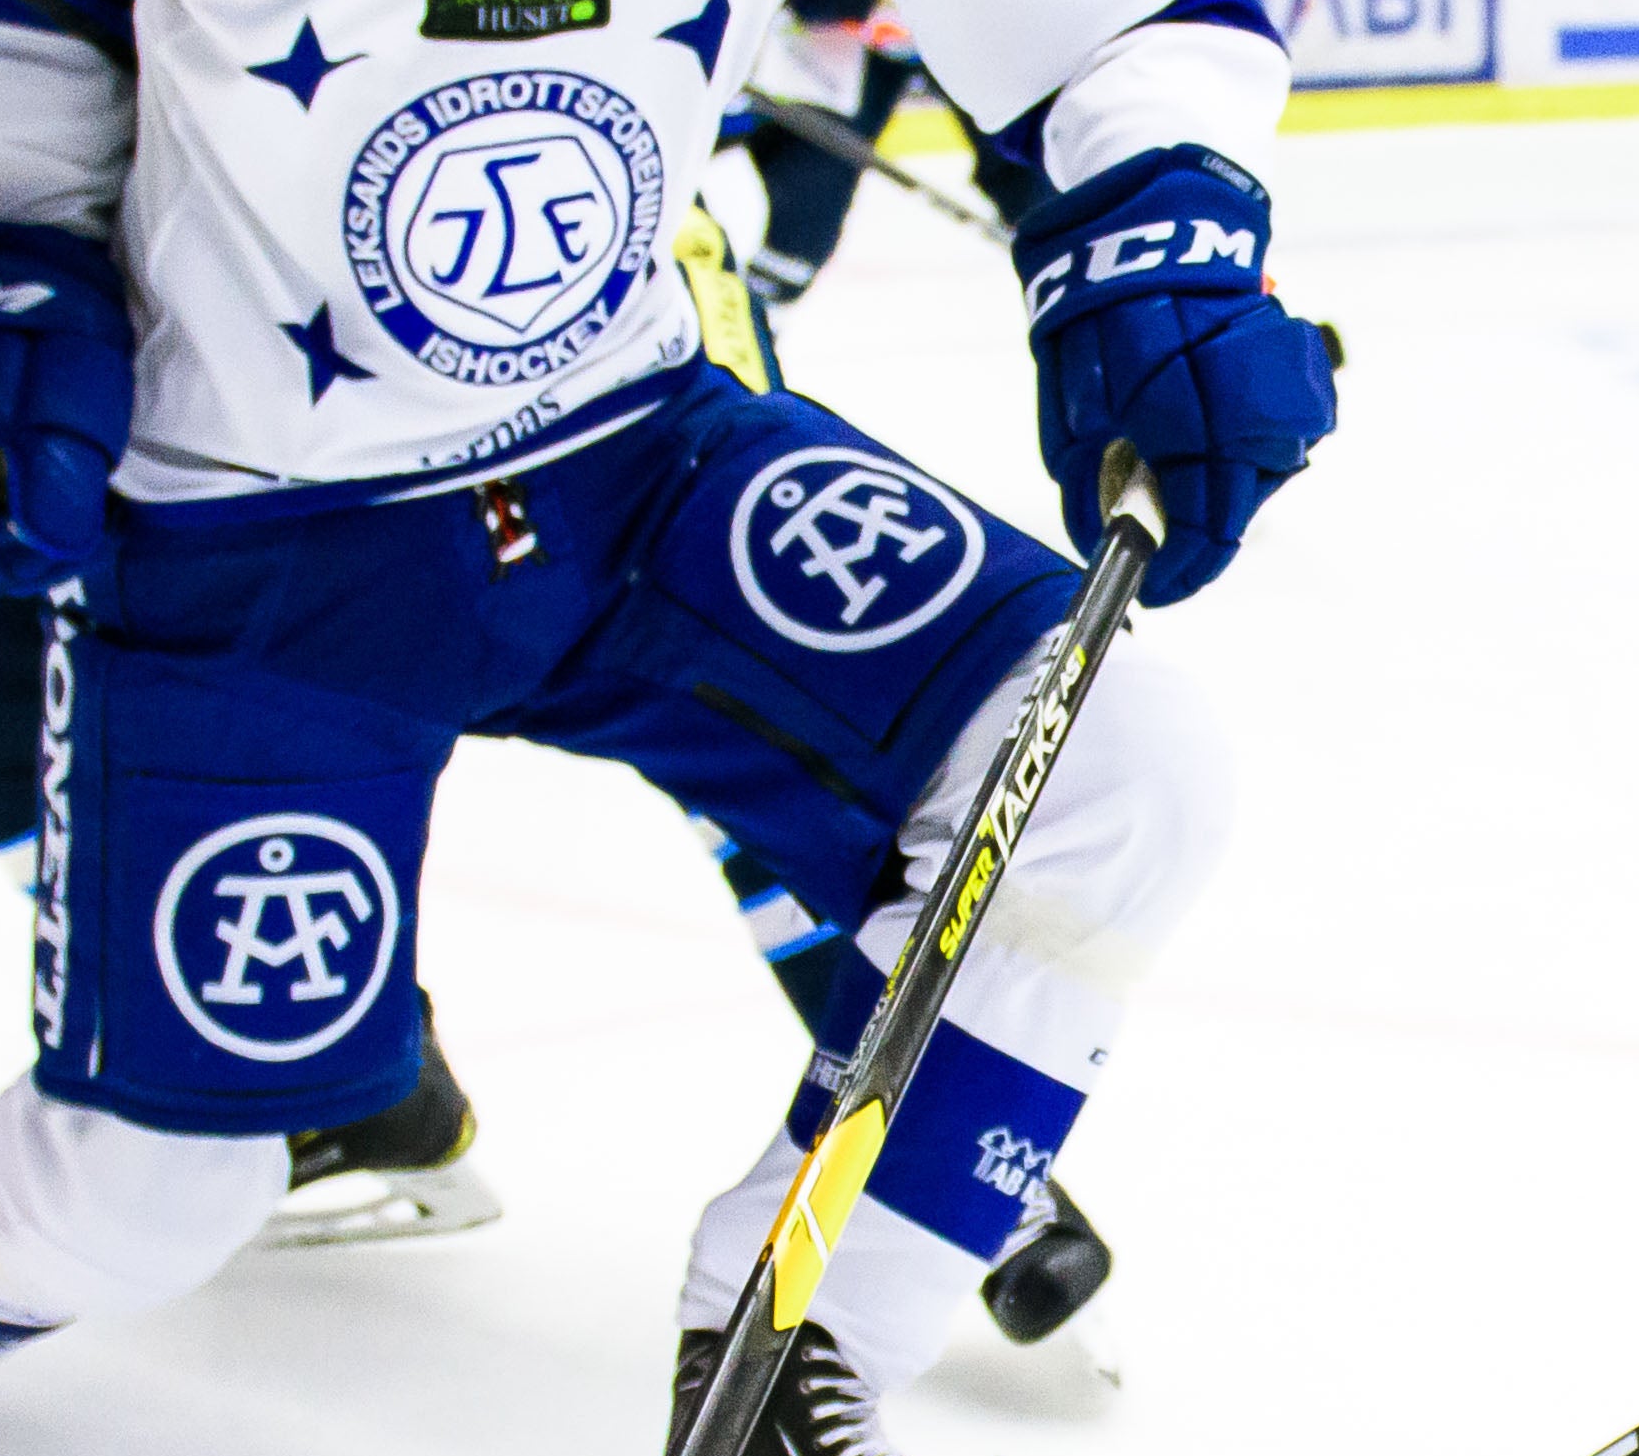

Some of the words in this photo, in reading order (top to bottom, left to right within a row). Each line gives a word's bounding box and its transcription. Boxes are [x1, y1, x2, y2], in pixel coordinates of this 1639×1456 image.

[345, 109, 431, 313] LEKSANDS
[1023, 218, 1257, 329] CCM
[416, 299, 613, 385] ISHOCKEY
[938, 845, 996, 961] SUPER
[977, 689, 1070, 864] TACKS
